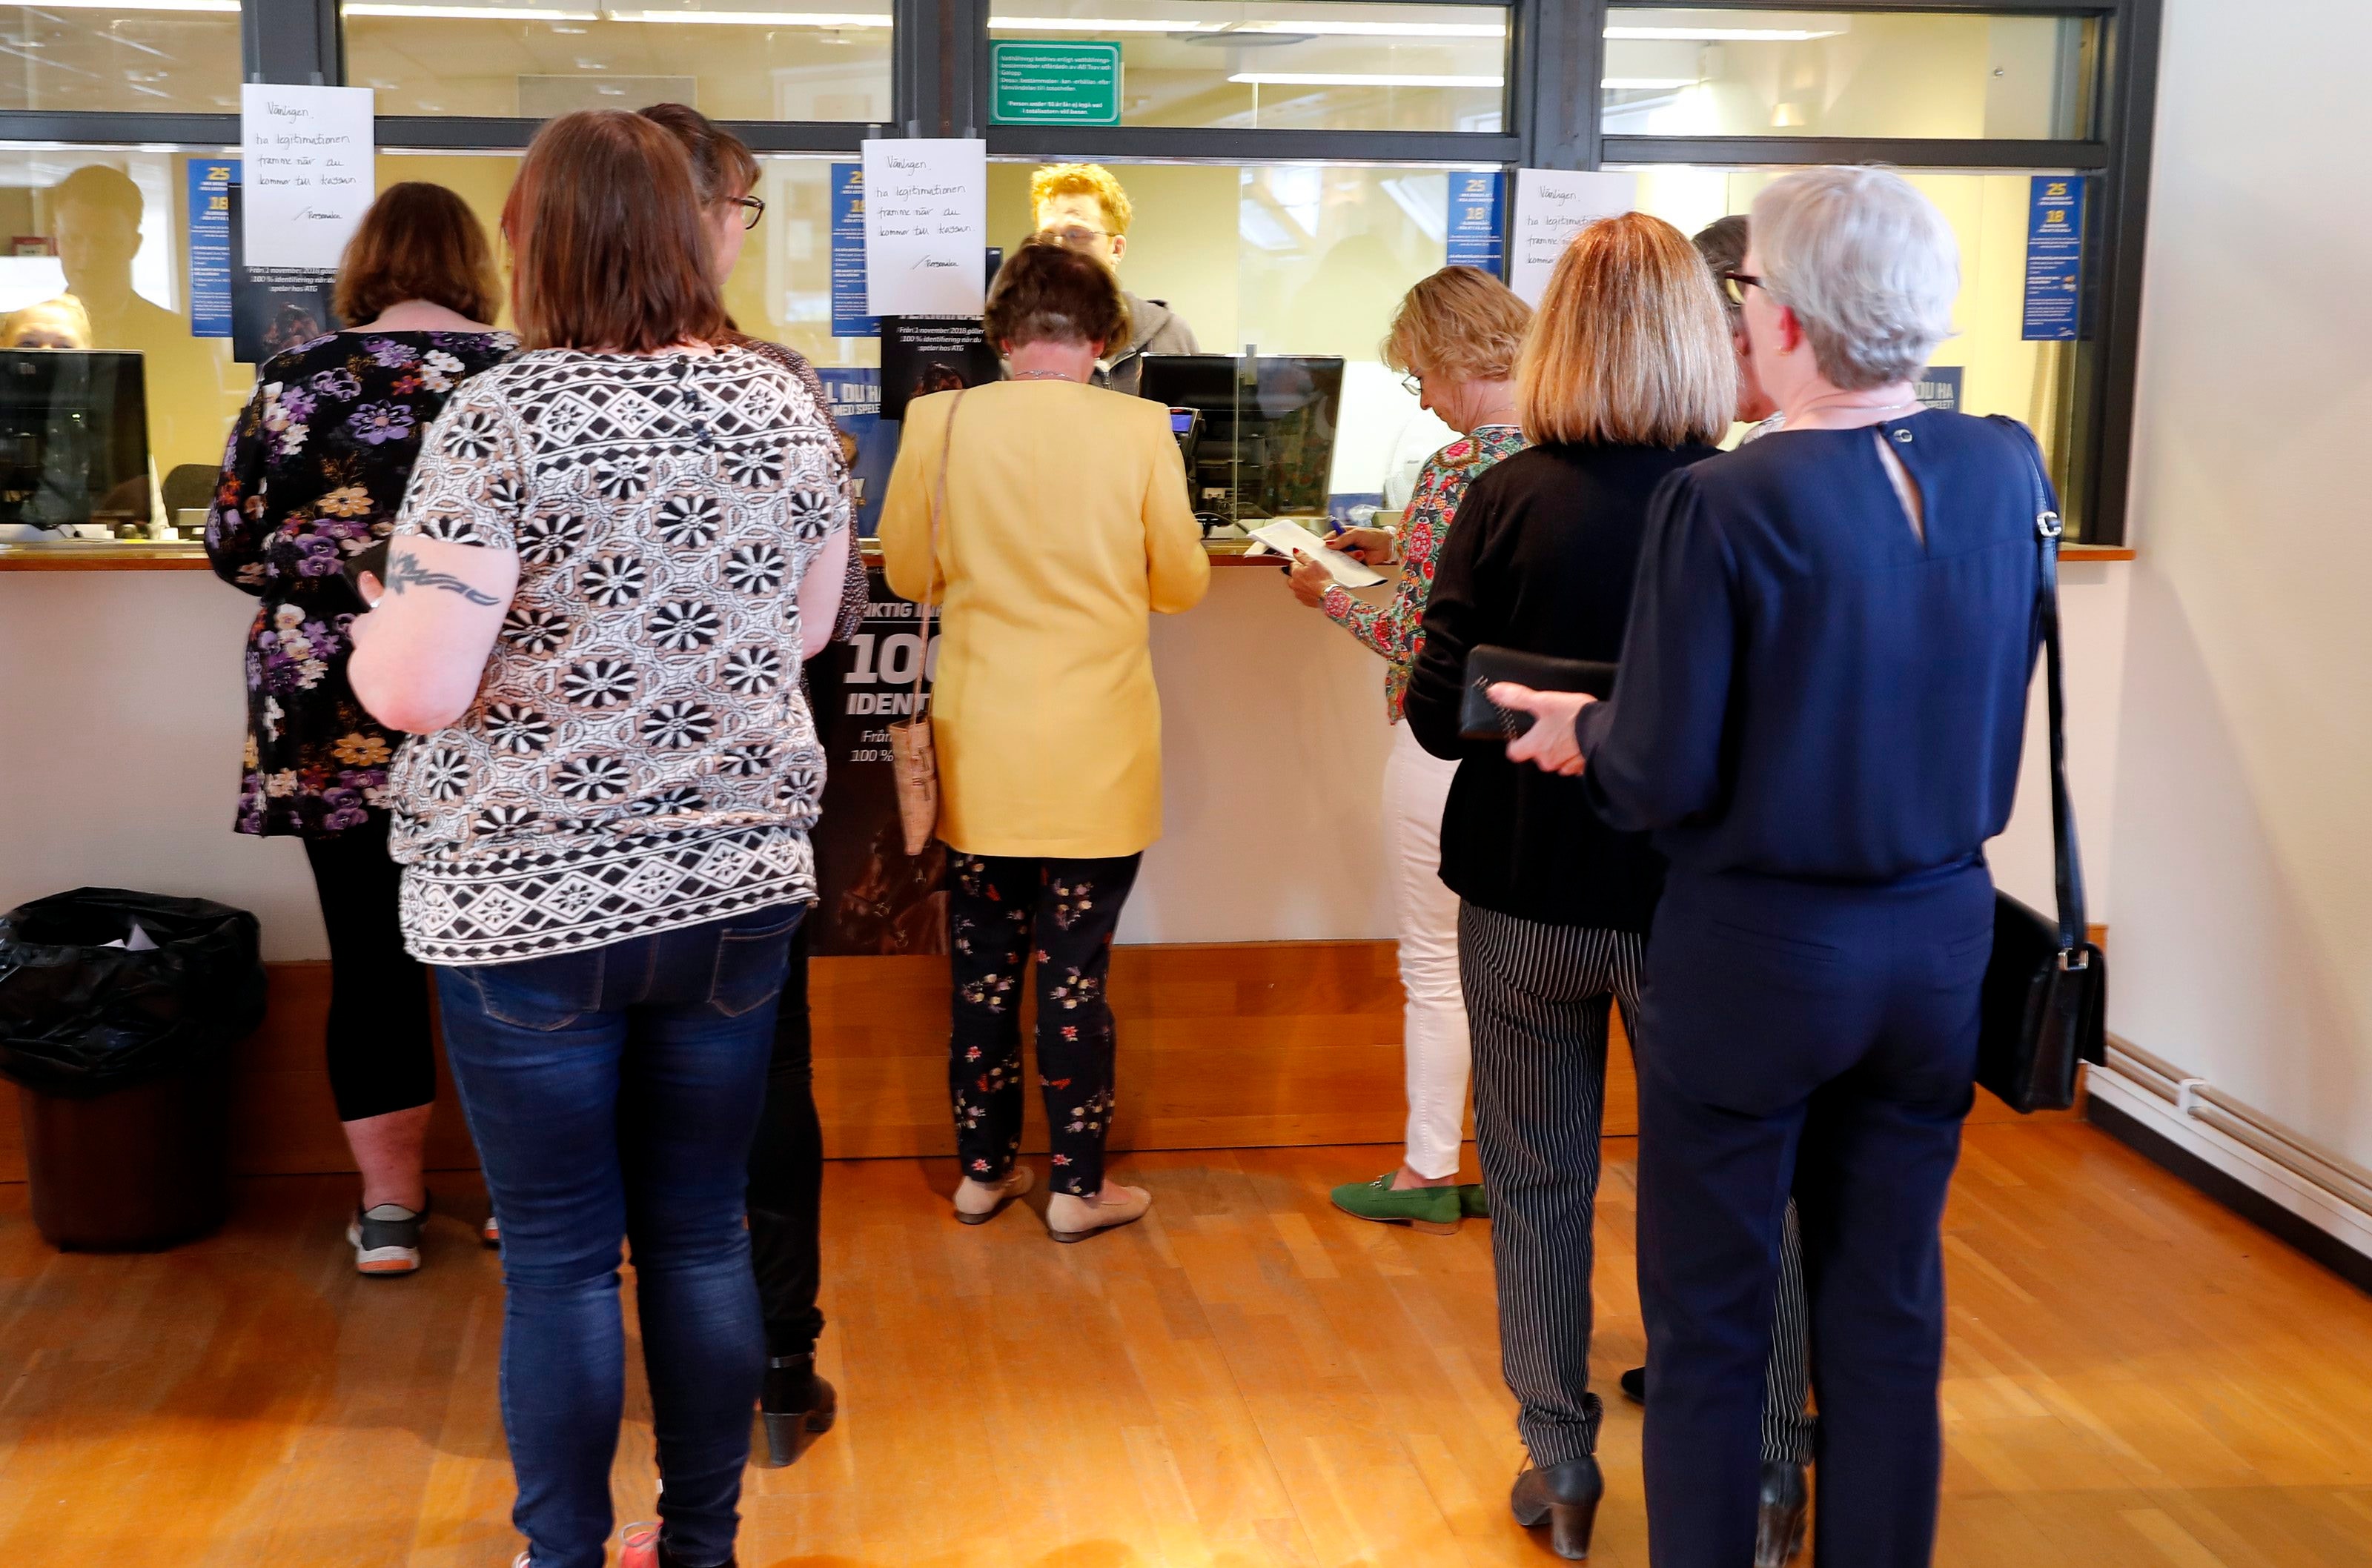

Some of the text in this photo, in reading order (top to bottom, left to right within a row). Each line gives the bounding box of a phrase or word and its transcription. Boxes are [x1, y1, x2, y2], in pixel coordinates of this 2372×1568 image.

[296, 156, 316, 165] när
[208, 167, 231, 180] 25
[849, 170, 864, 184] 2
[1466, 179, 1486, 192] 25
[2046, 183, 2067, 196] 25
[914, 207, 933, 216] när
[1465, 207, 1485, 220] 18
[2046, 210, 2065, 223] 18
[967, 328, 984, 336] gäller
[841, 383, 866, 403] DU
[1937, 382, 1954, 399] HA
[831, 403, 881, 416] MED SPELE
[864, 602, 913, 618] IKTIG
[860, 729, 892, 743] Från
[850, 748, 894, 763] 100 %
